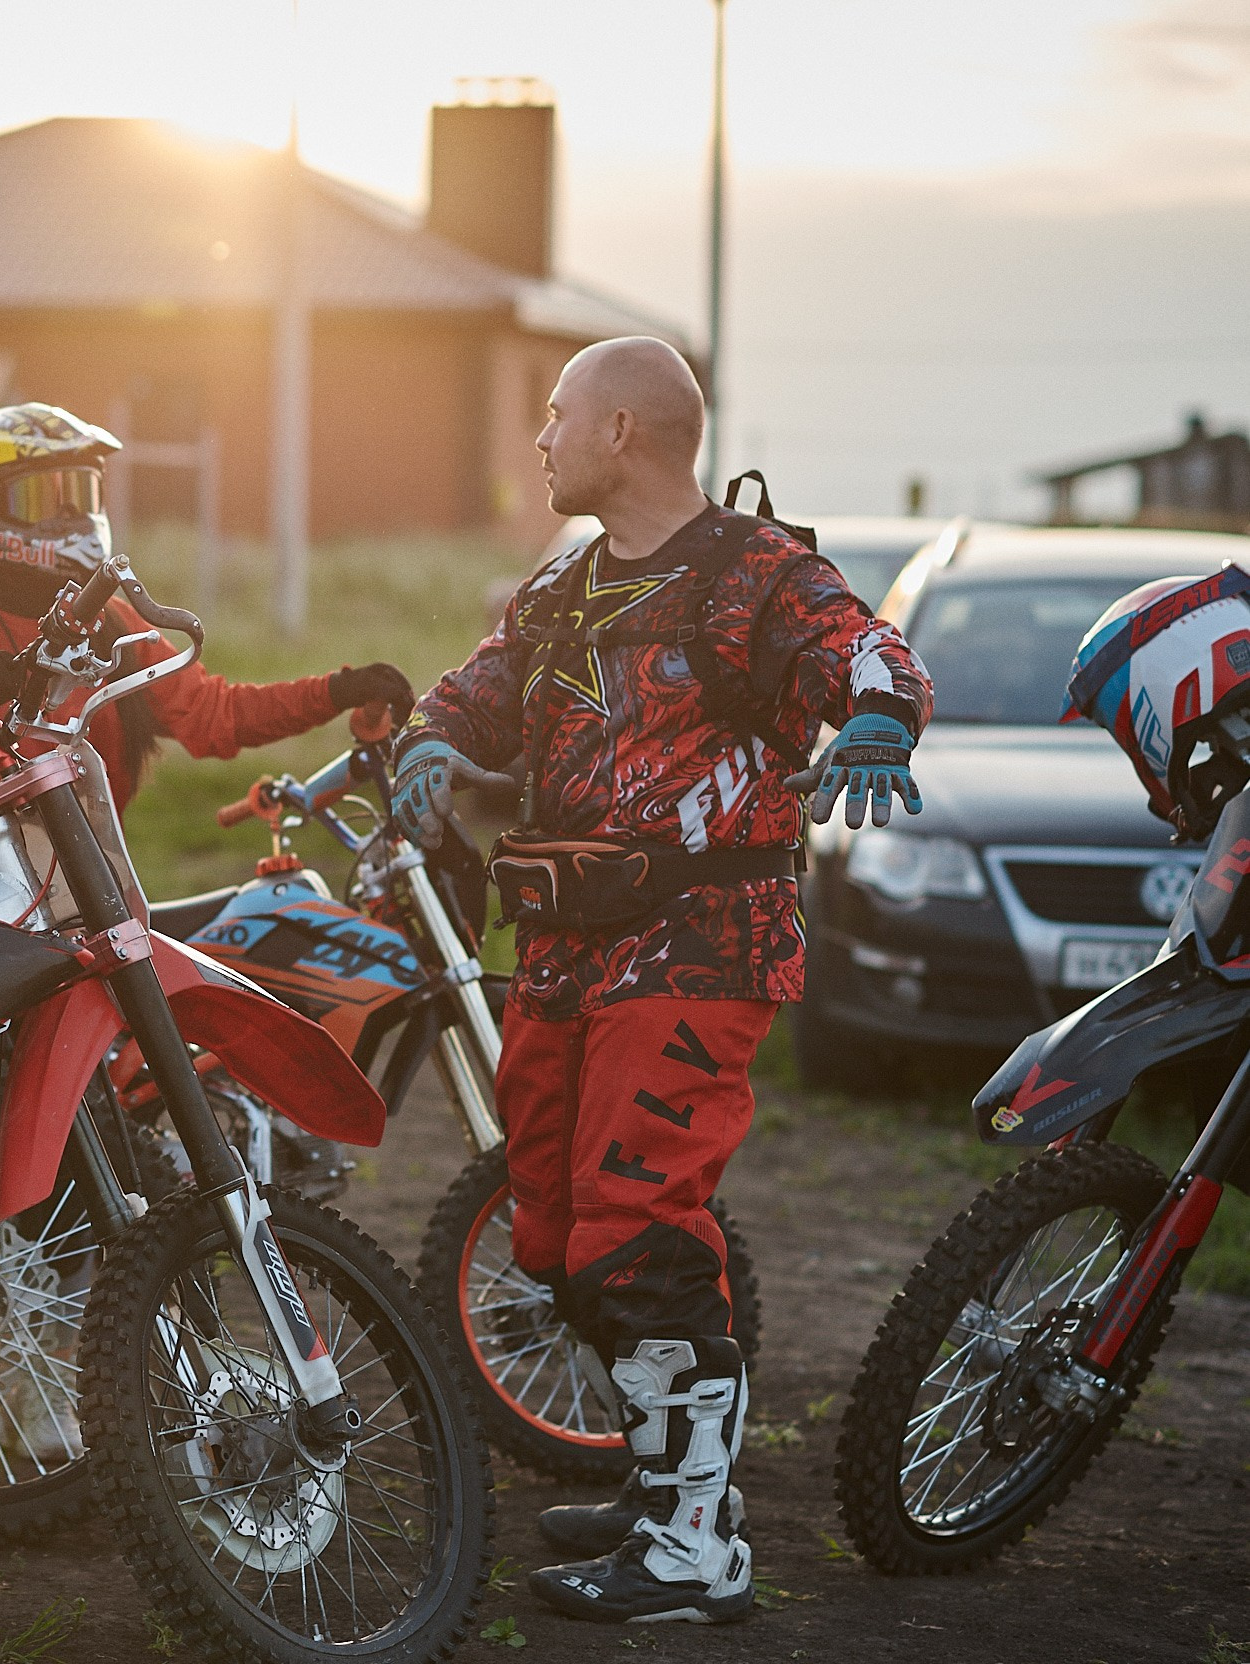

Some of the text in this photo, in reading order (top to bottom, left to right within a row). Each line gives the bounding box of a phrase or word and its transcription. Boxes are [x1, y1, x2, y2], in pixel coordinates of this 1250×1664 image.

[7, 537, 56, 568] Bull
[1129, 573, 1226, 649] LEATT
[599, 1018, 722, 1185] FLY
[561, 1575, 603, 1599] 3.5
